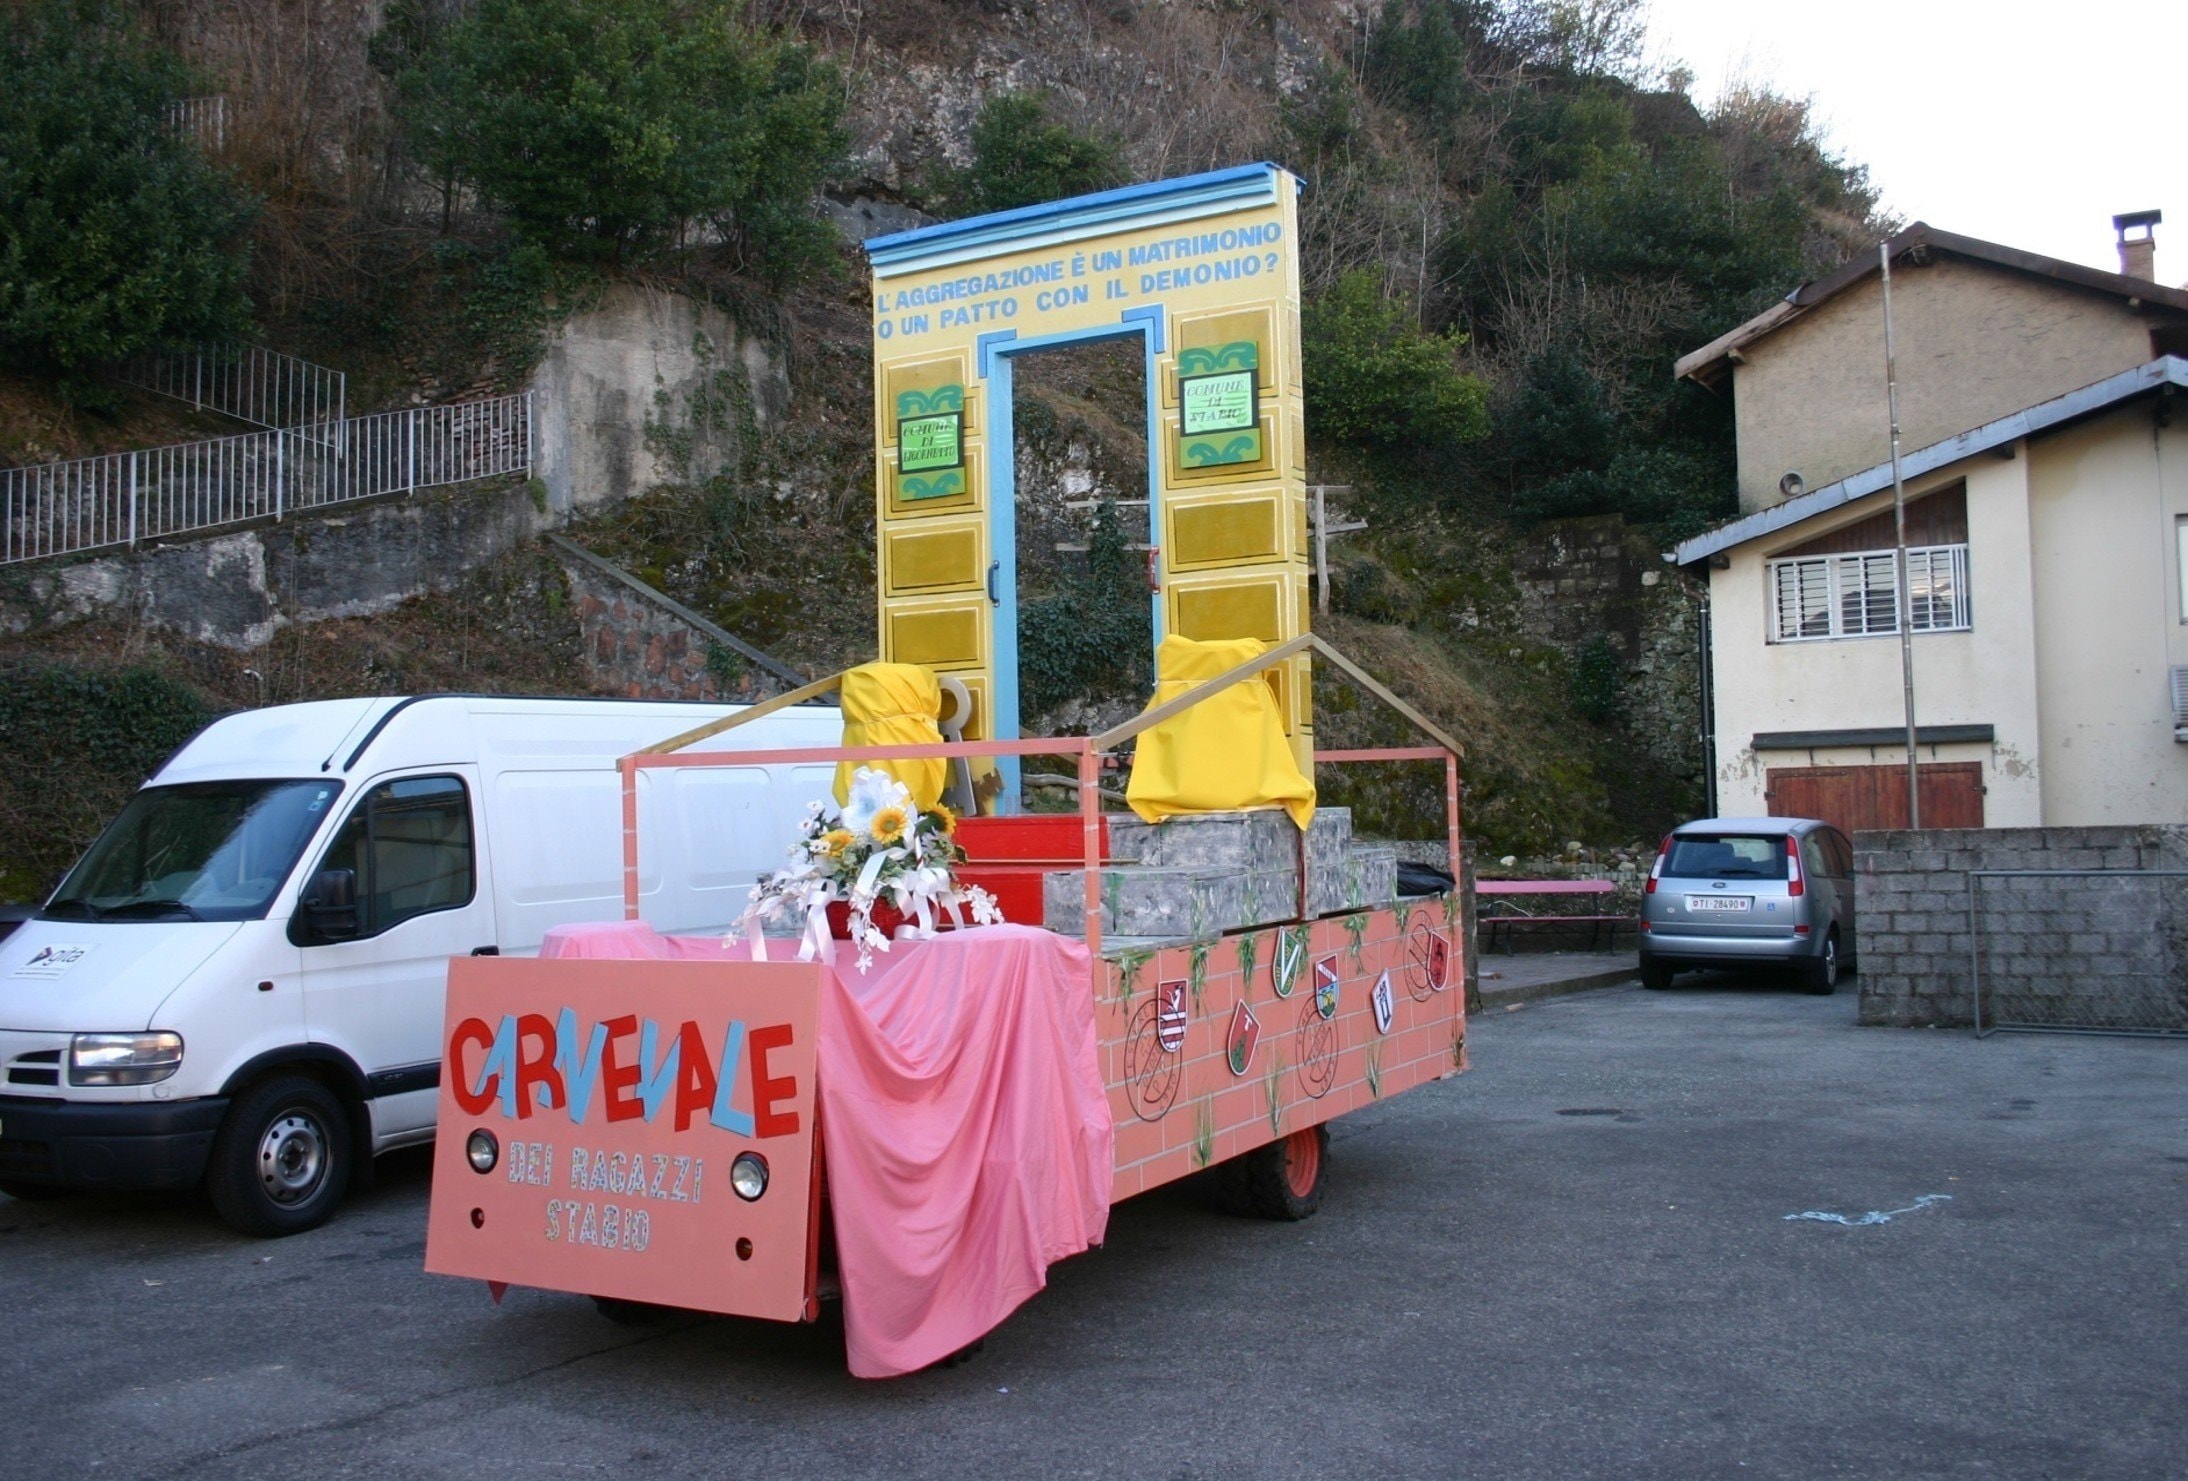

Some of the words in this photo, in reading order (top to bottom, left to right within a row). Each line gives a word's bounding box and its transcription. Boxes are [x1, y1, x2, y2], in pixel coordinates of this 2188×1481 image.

[1092, 250, 1122, 272] UN
[1128, 222, 1282, 267] MATRIMONIO
[877, 319, 894, 340] O
[901, 313, 929, 335] UN
[940, 297, 1018, 329] PATTO
[1036, 284, 1089, 311] CON
[1106, 278, 1129, 299] IL
[1140, 252, 1279, 294] DEMONIO?
[1186, 380, 1245, 397] COMUNE
[921, 436, 935, 448] DI
[449, 1006, 800, 1139] CARNEVALE
[509, 1141, 554, 1187] DEI
[570, 1147, 703, 1203] RAGAZZI
[545, 1199, 651, 1253] STABIO
